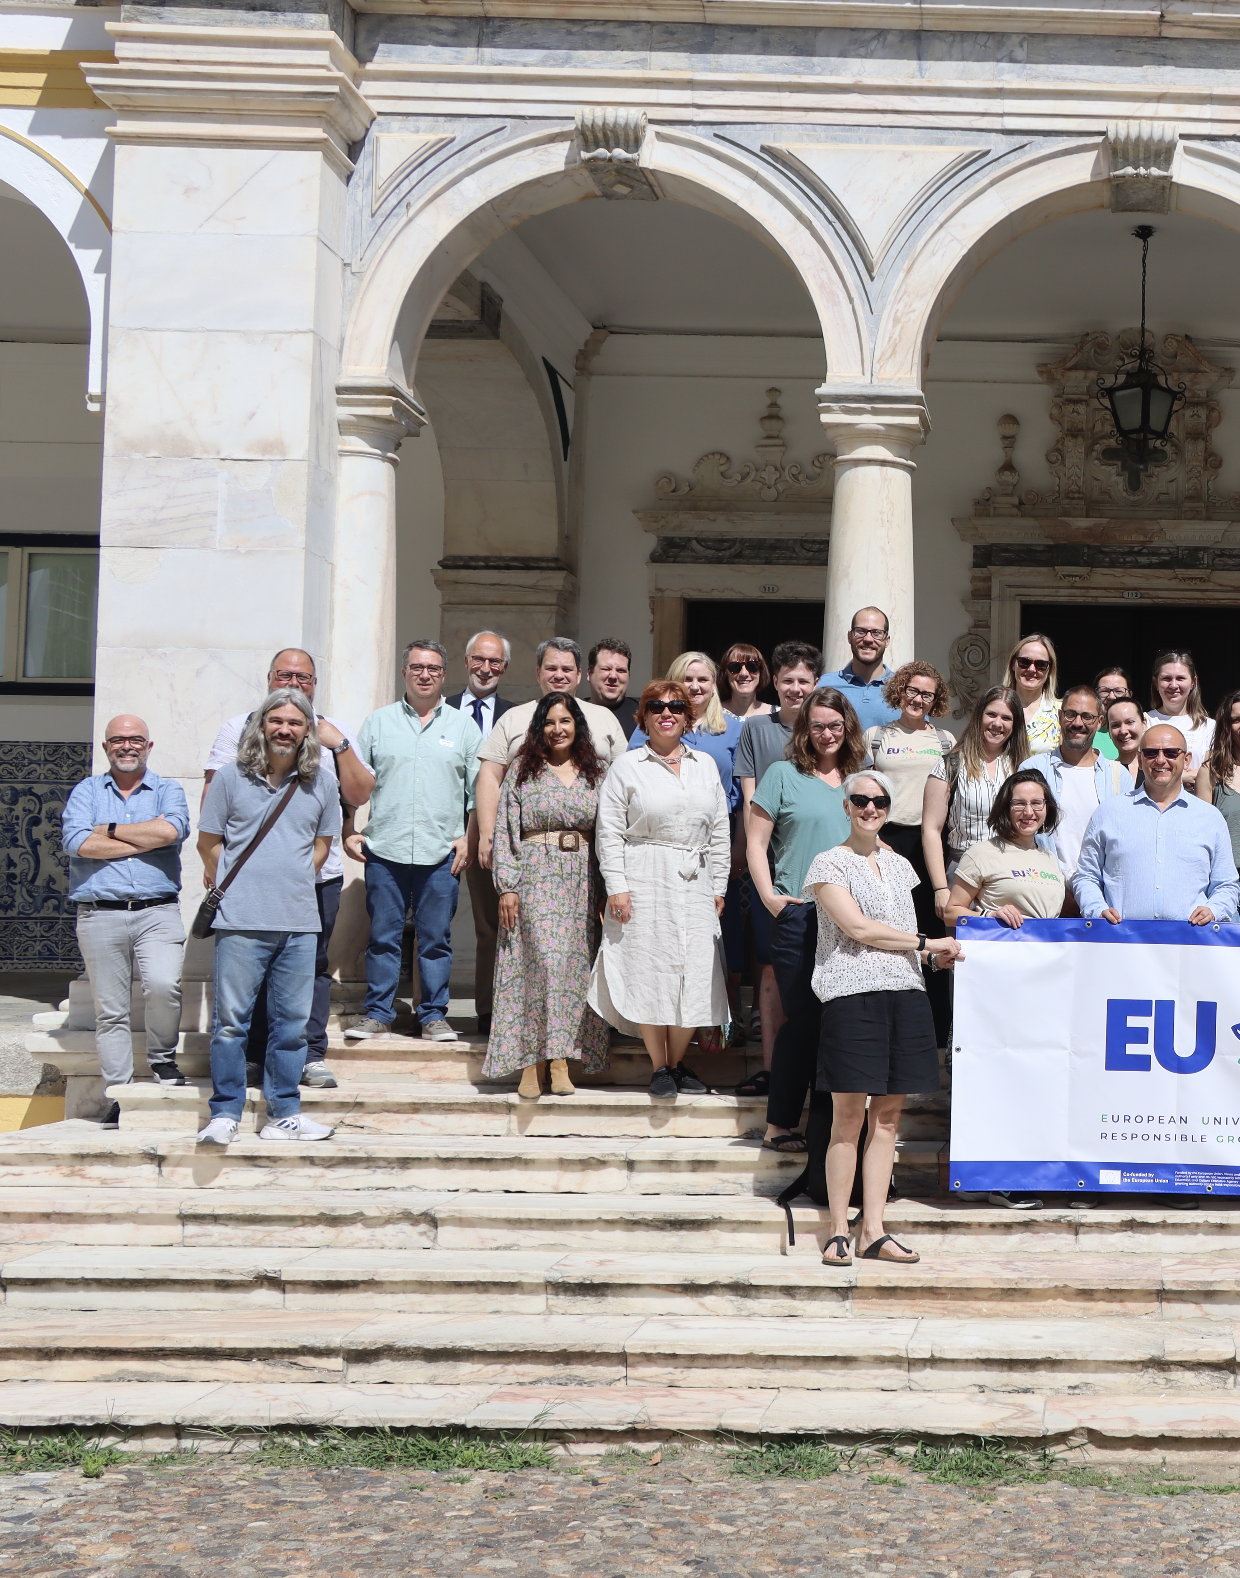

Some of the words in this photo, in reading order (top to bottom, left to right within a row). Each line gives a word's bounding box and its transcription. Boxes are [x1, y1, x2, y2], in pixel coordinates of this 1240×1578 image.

[886, 747, 900, 755] EU
[1011, 869, 1026, 878] EU
[1105, 998, 1218, 1075] EU
[1101, 1114, 1188, 1126] EUROPEAN
[1100, 1132, 1207, 1143] RESPONSIBLE
